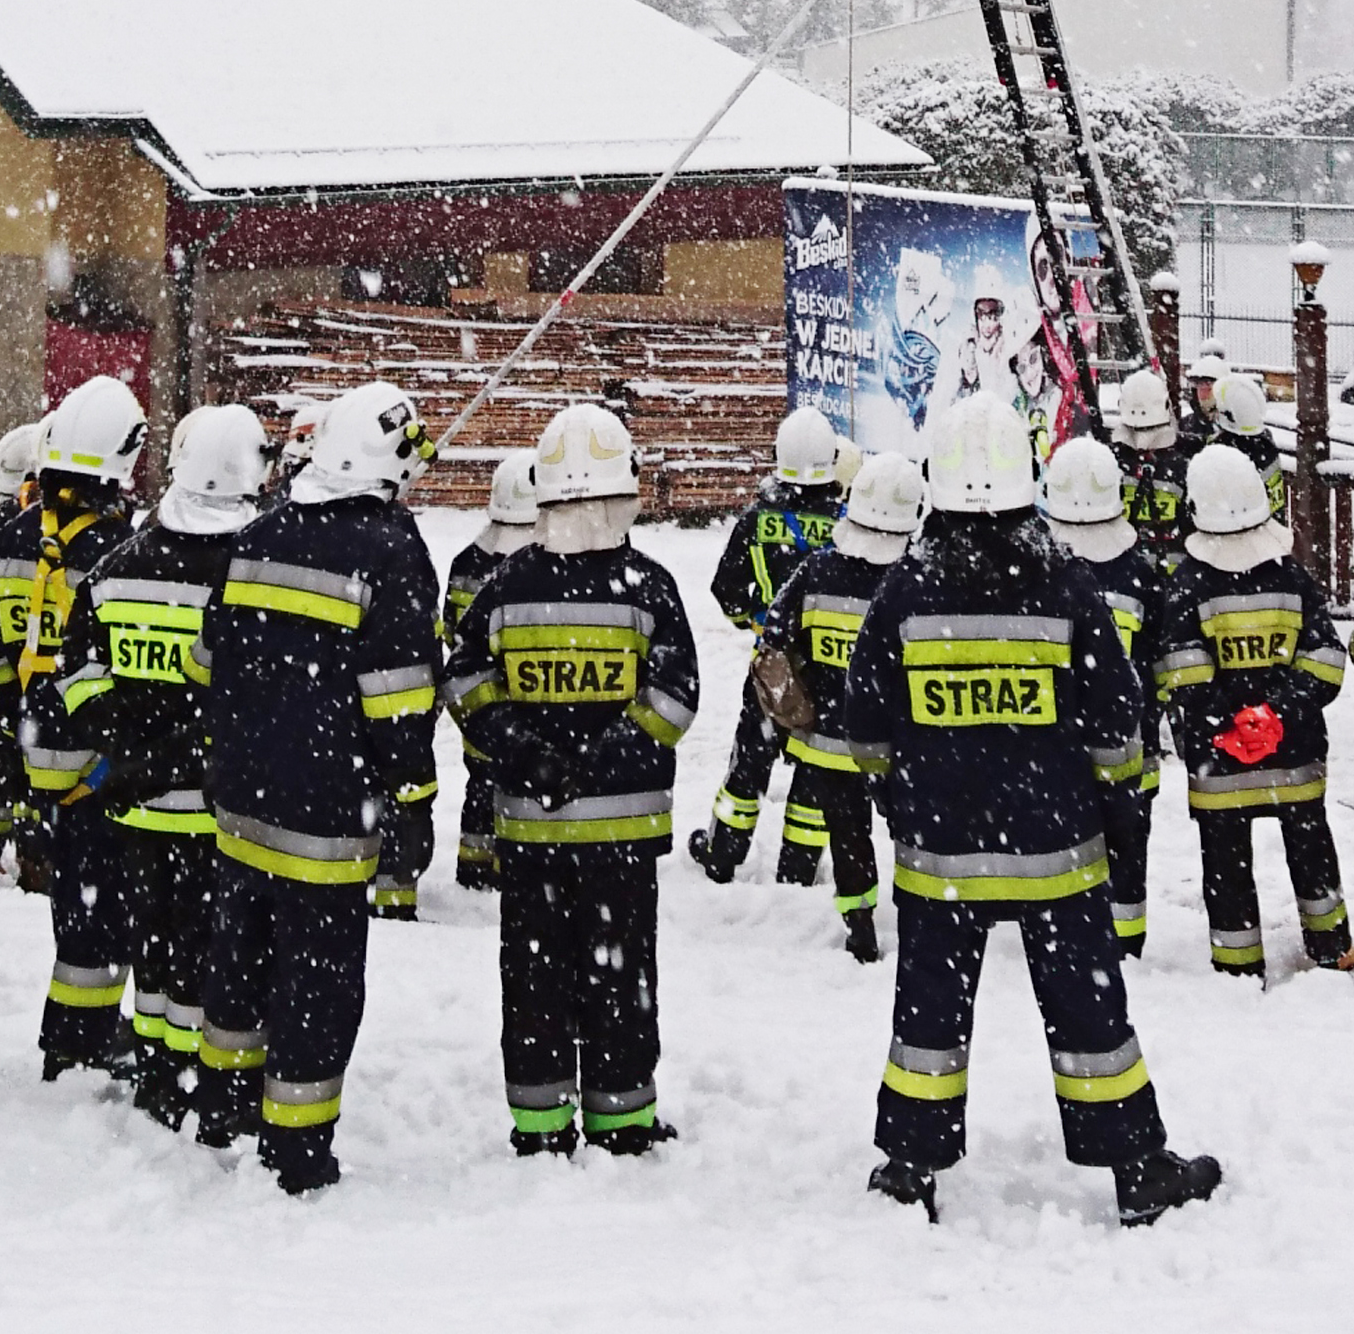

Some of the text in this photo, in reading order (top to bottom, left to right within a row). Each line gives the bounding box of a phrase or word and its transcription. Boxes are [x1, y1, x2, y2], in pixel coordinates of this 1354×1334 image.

[796, 292, 850, 320] BESKIDY
[795, 318, 880, 361] W JEDNEJ
